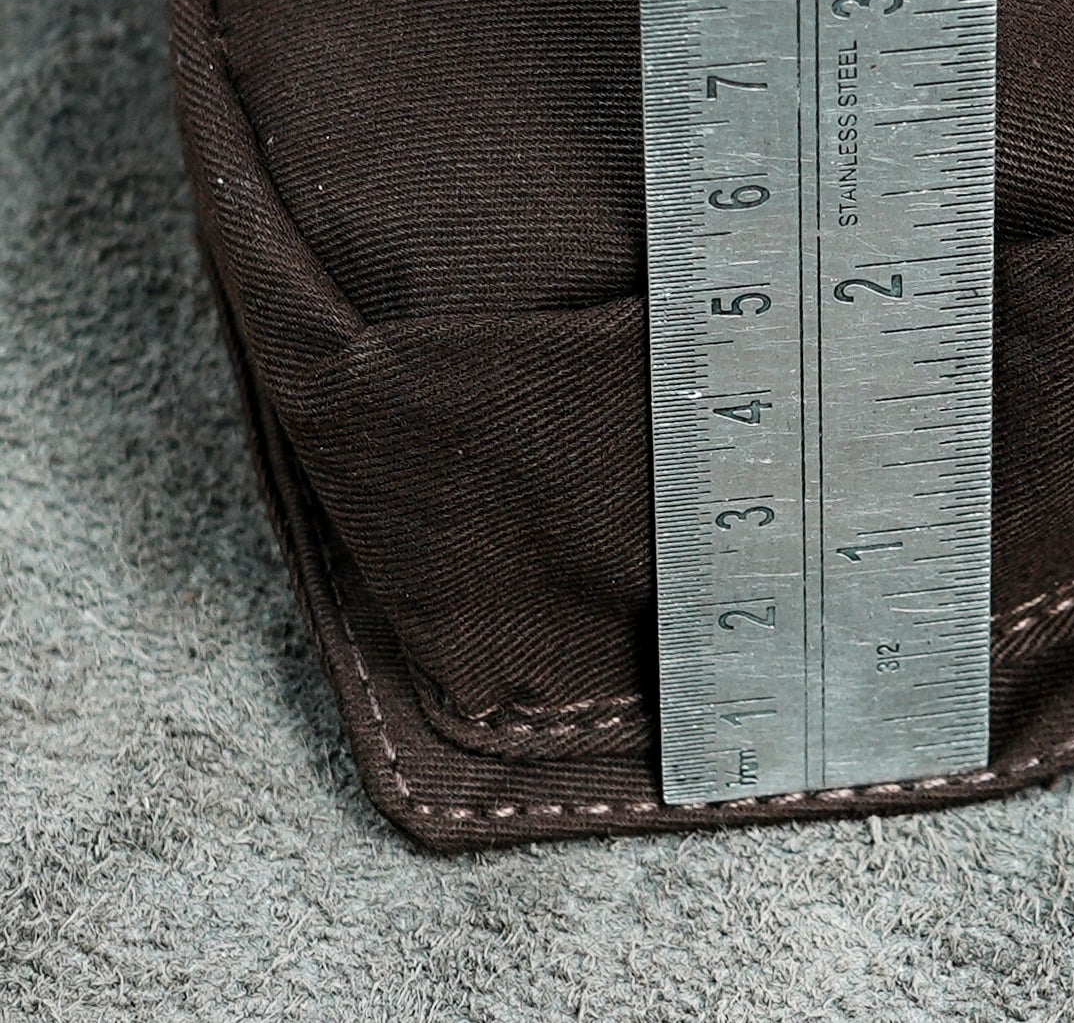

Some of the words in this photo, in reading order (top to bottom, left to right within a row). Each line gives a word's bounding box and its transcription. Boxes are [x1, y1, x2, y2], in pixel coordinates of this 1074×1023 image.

[838, 40, 859, 108] STEEL
[706, 75, 768, 100] 7
[838, 113, 859, 227] STAINLESS
[708, 185, 770, 212] 6
[833, 274, 902, 304] 2
[711, 292, 771, 317] 5
[713, 399, 773, 425] 4
[715, 506, 775, 530] 3
[836, 541, 903, 564] 1
[718, 606, 776, 631] 2
[876, 643, 900, 674] 32
[719, 709, 777, 726] 1
